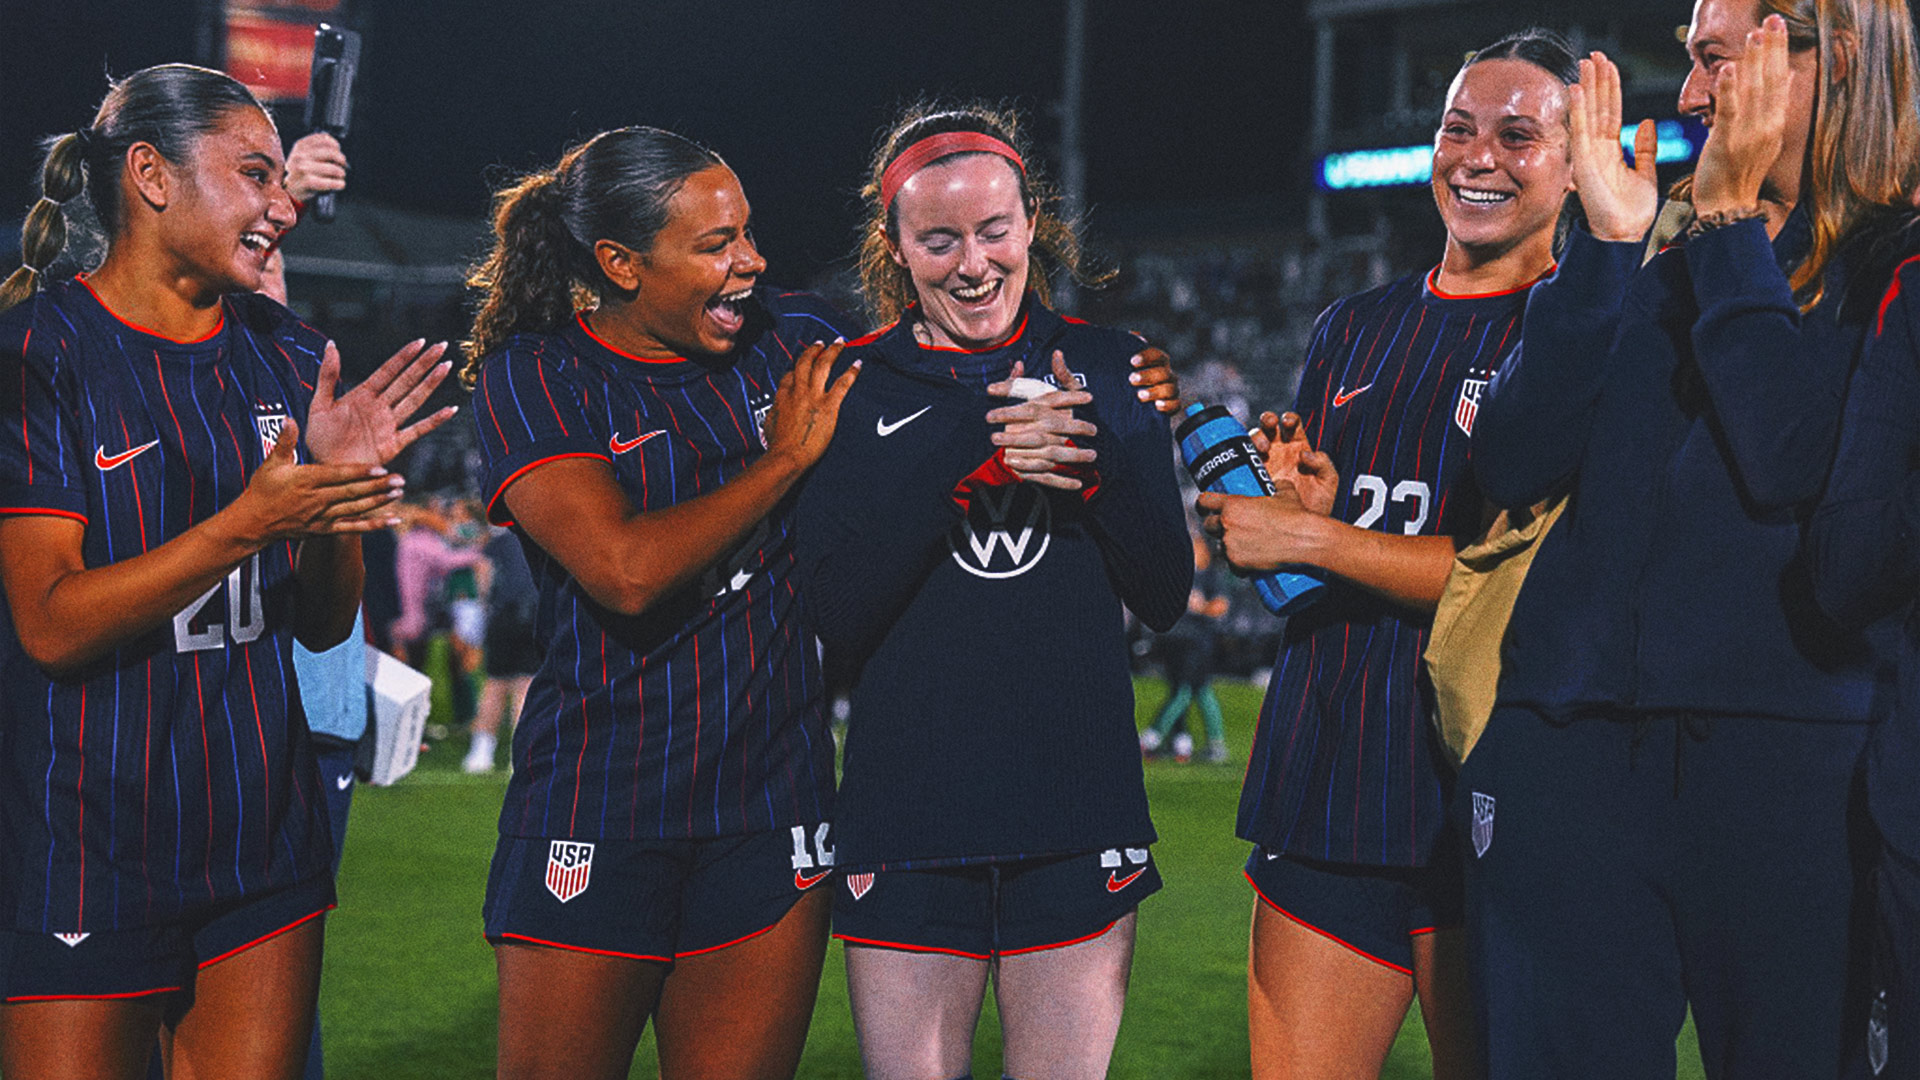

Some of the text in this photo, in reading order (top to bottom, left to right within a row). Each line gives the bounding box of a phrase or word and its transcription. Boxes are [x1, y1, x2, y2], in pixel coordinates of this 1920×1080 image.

[1352, 474, 1430, 535] 23
[173, 552, 264, 653] 20
[551, 843, 591, 868] USA
